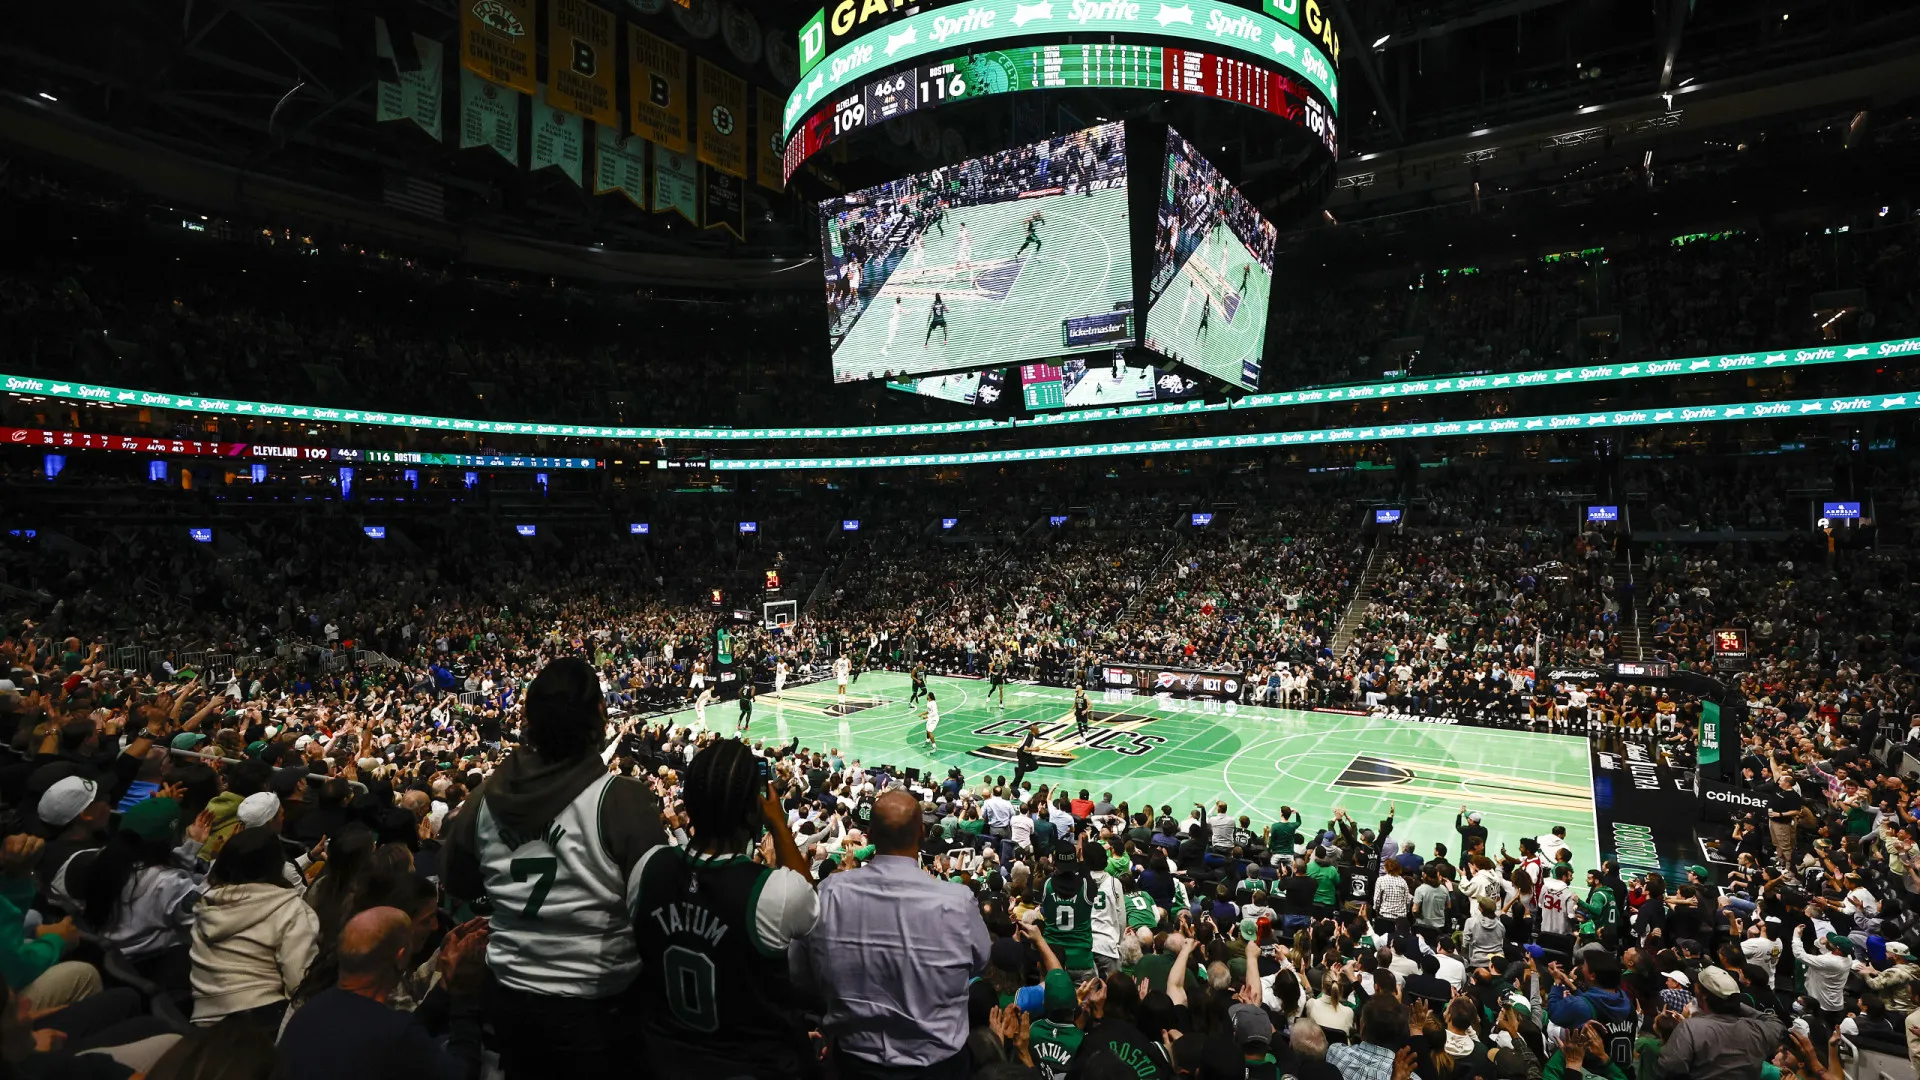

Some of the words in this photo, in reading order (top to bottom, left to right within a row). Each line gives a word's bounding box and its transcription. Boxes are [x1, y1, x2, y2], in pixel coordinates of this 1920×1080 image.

[830, 44, 873, 83] Sprite
[930, 7, 996, 51] Sprite
[1068, 0, 1141, 25] Sprite
[1206, 10, 1263, 43] Sprite
[1302, 47, 1329, 85] Sprite
[571, 36, 597, 78] B
[929, 63, 954, 79] BOSTON
[650, 72, 671, 109] B
[875, 77, 906, 98] 46.6
[920, 73, 966, 103] 116
[836, 94, 859, 113] CLEVELAND
[834, 103, 866, 136] 109
[1304, 105, 1324, 137] 109
[1070, 324, 1123, 338] ticketmaster
[6, 378, 43, 391] Sprite
[78, 386, 111, 398] Sprite
[141, 394, 170, 405] Sprite
[199, 400, 229, 411] Sprite
[258, 404, 286, 415] Sprite
[313, 409, 339, 419] Sprite
[363, 413, 387, 423] Sprite
[410, 417, 432, 426] Sprite
[453, 420, 474, 430] Sprite
[494, 423, 516, 432] Sprite
[536, 425, 557, 434] Sprite
[577, 427, 598, 436] Sprite
[1122, 407, 1143, 417] Sprite
[1250, 395, 1275, 406] Sprite
[1298, 392, 1323, 402] Sprite
[1348, 387, 1375, 399] Sprite
[1401, 383, 1429, 394] Sprite
[1457, 378, 1487, 390] Sprite
[1516, 373, 1548, 385] Sprite
[1579, 367, 1613, 380] Sprite
[1646, 362, 1682, 375] Sprite
[1718, 356, 1755, 368] Sprite
[1795, 349, 1836, 362] Sprite
[1150, 442, 1171, 452] Sprite
[1191, 439, 1213, 450] Sprite
[1235, 436, 1258, 447] Sprite
[1280, 433, 1304, 444] Sprite
[1328, 430, 1355, 442] Sprite
[1379, 427, 1406, 438] Sprite
[1432, 424, 1462, 435] Sprite
[1489, 420, 1520, 432] Sprite
[1549, 416, 1582, 428] Sprite
[1613, 412, 1647, 424] Sprite
[1680, 408, 1717, 421] Sprite
[1752, 404, 1791, 417] Sprite
[1830, 399, 1872, 412] Sprite
[252, 446, 298, 458] CLEVELAND
[304, 448, 328, 459] 109
[338, 450, 358, 458] 46.6
[370, 452, 391, 462] 116
[394, 453, 422, 462] BOSTON
[767, 576, 779, 588] 24
[1718, 632, 1737, 640] 46.6
[1722, 640, 1739, 650] 24
[1122, 674, 1133, 685] CUP
[1203, 678, 1222, 691] NEXT
[1386, 713, 1421, 722] NBA
[1423, 716, 1460, 726] CUP
[1704, 723, 1716, 731] GET
[1705, 731, 1716, 740] THE
[1630, 765, 1661, 790] ULTRA
[1706, 791, 1769, 808] coinbas
[1612, 821, 1661, 870] BOSTON
[510, 857, 558, 917] 7
[1132, 896, 1148, 910] 0
[1544, 894, 1563, 912] 34
[651, 902, 729, 947] TATUM
[1056, 905, 1075, 931] 0
[1609, 908, 1616, 923] 0
[663, 945, 720, 1033] 0
[1606, 1020, 1634, 1034] TATUM
[1034, 1042, 1072, 1066] TATUM
[1109, 1041, 1160, 1080] BOSTO
[1610, 1036, 1633, 1068] 0
